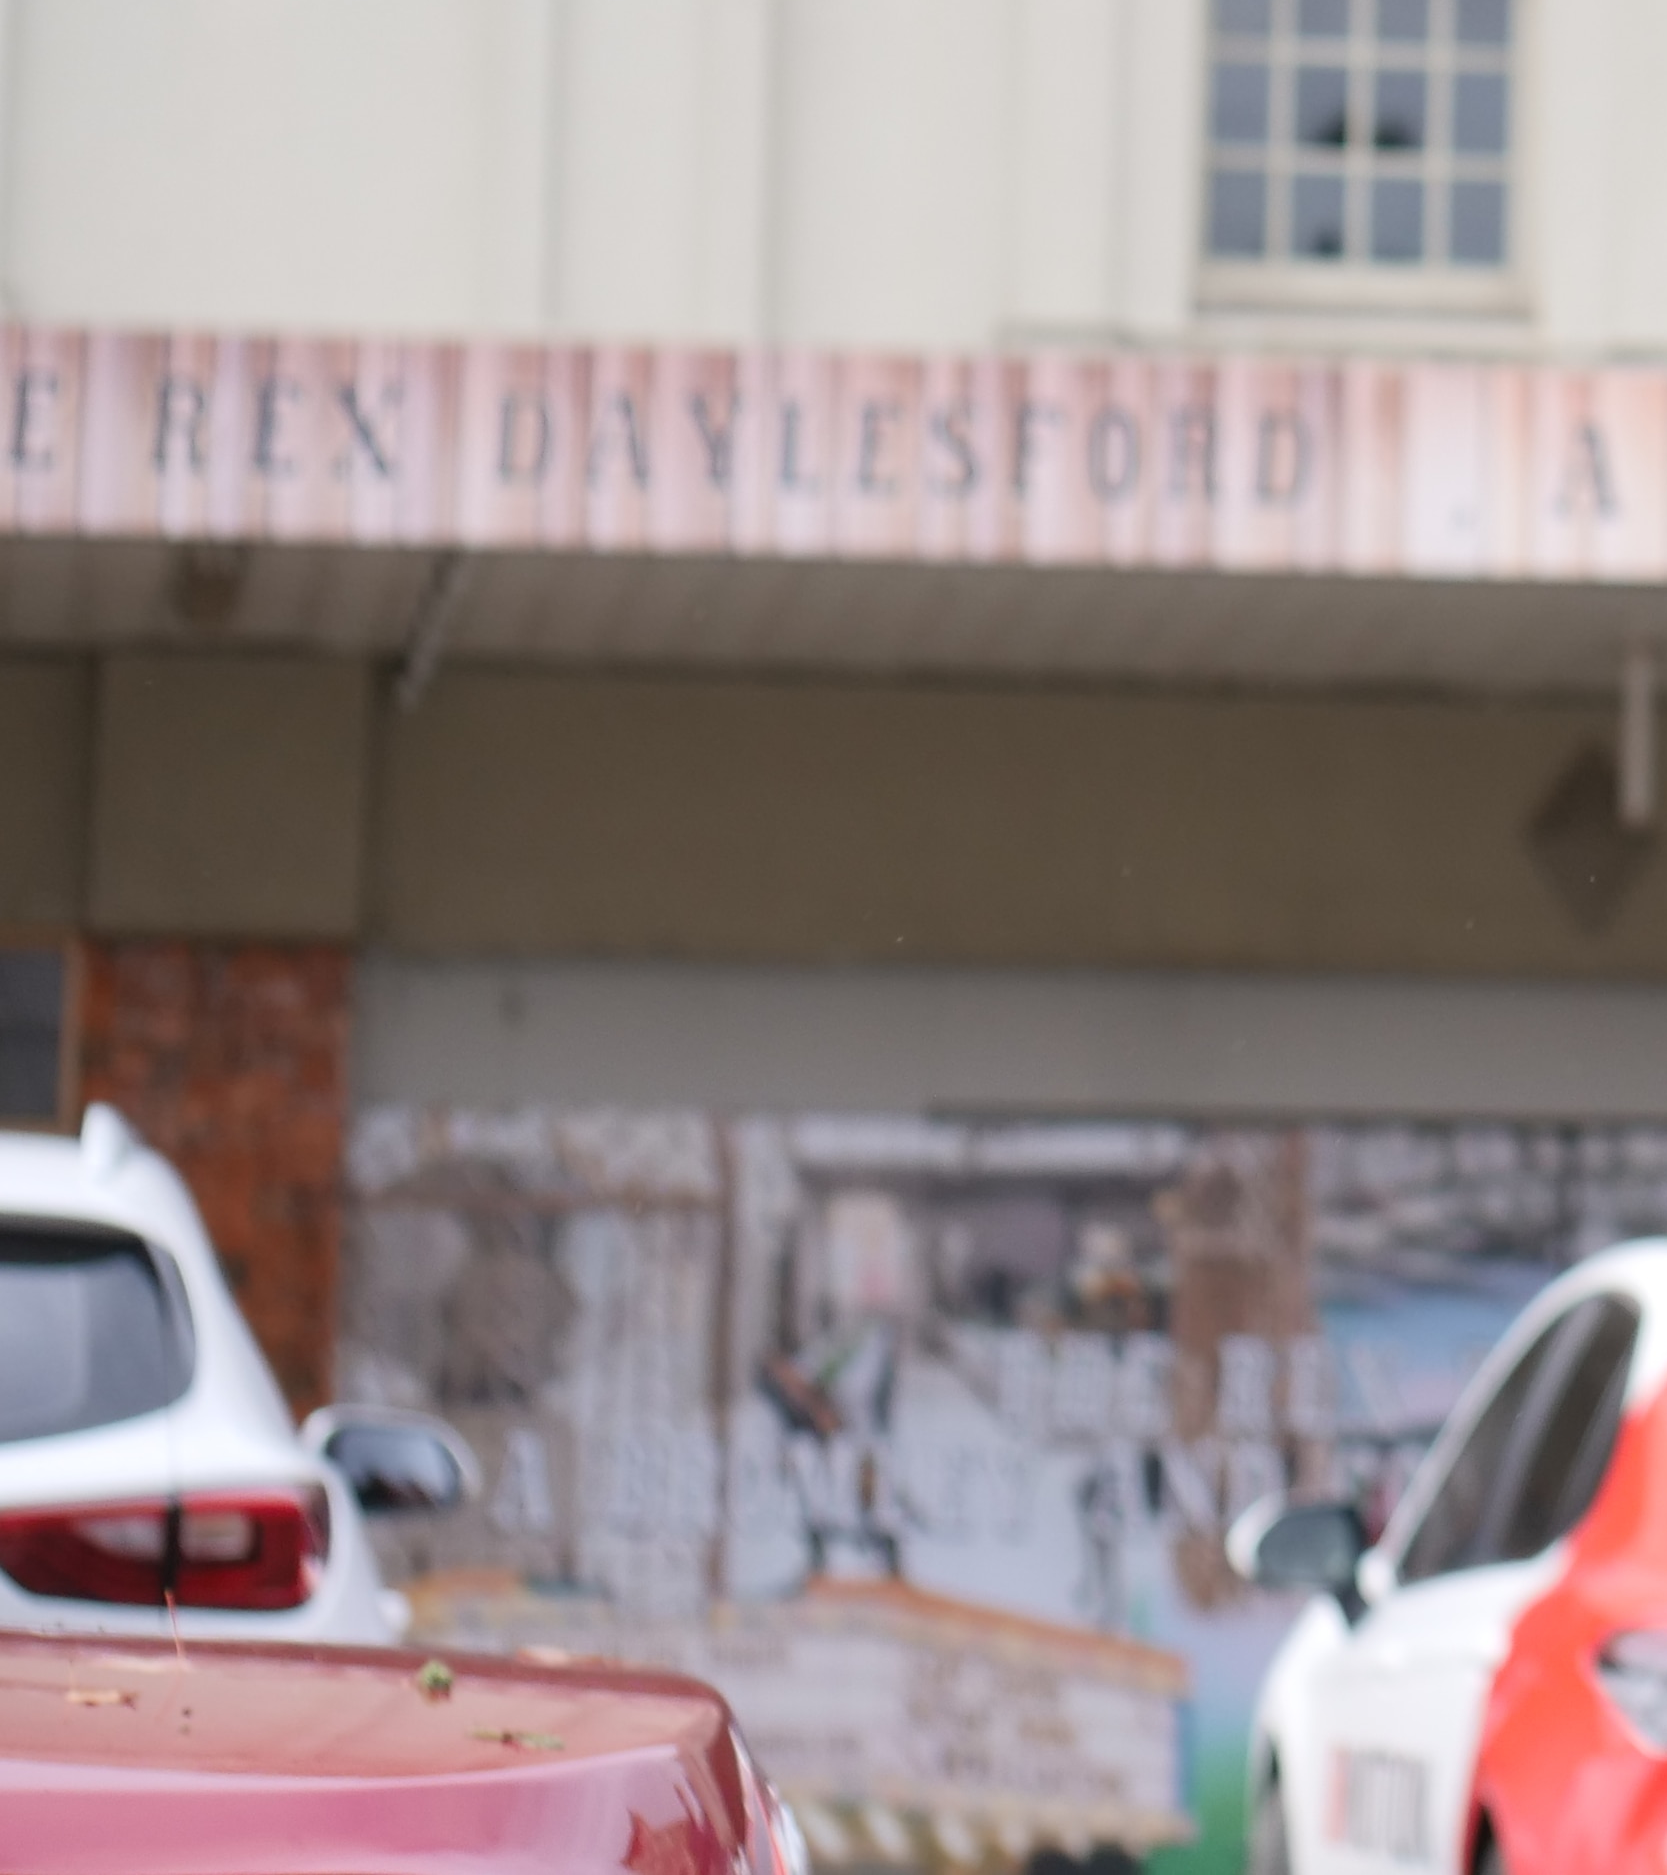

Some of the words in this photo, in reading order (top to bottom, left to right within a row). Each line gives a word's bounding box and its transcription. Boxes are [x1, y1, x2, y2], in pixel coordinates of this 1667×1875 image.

[151, 371, 406, 483] REX
[494, 387, 1318, 510] DAYLESFORD
[1554, 423, 1620, 523] A
